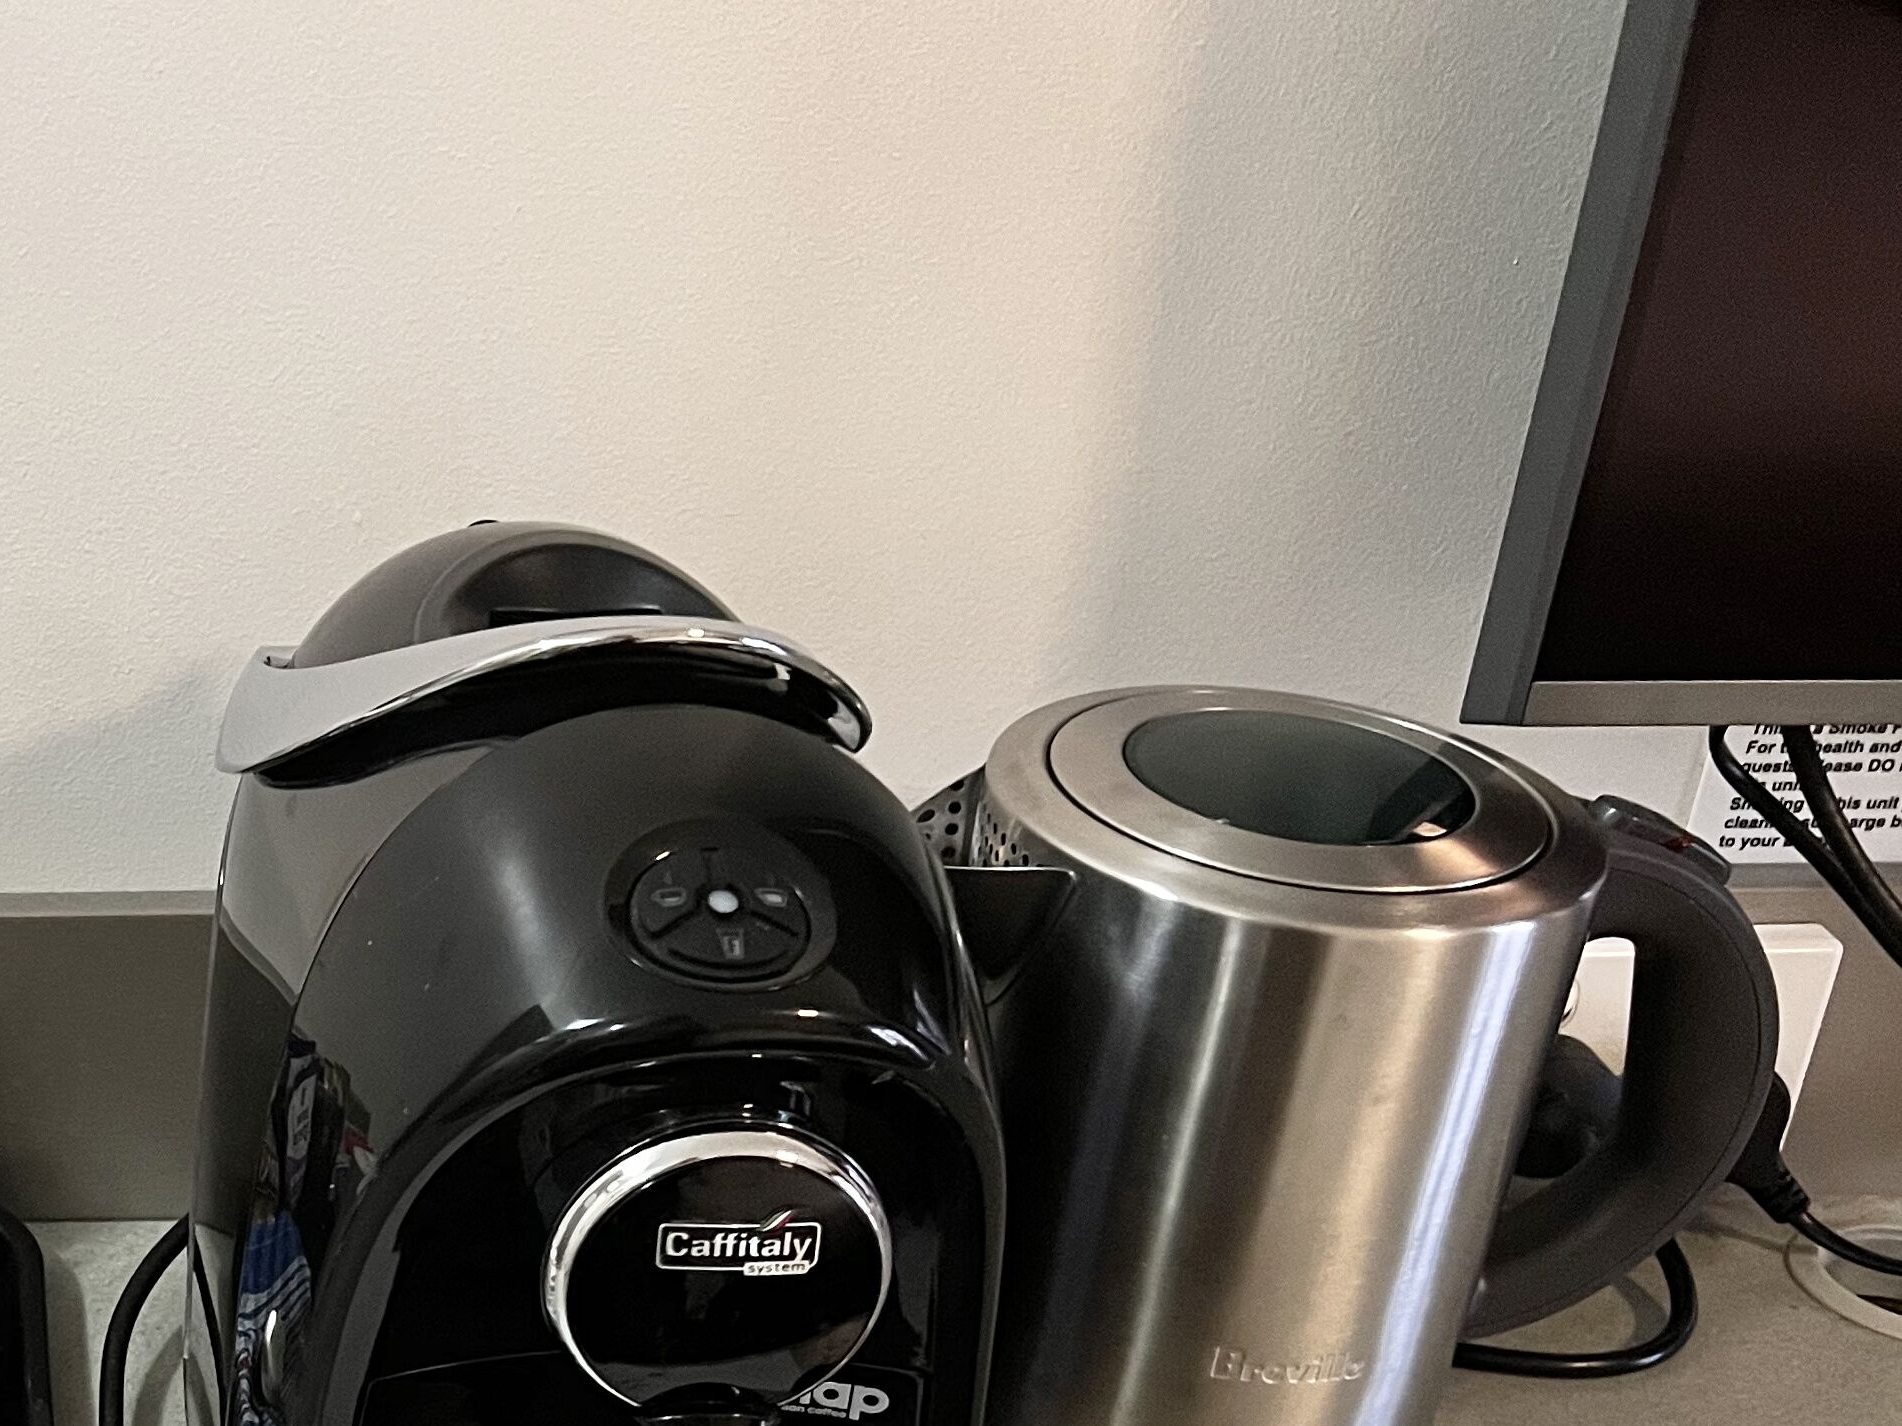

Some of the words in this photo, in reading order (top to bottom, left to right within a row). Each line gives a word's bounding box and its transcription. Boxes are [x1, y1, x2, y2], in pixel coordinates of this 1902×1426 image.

[1745, 740, 1777, 754] For
[1868, 758, 1896, 772] DO
[1866, 796, 1900, 810] unit
[1718, 835, 1736, 848] to
[1738, 836, 1781, 851] your
[665, 1231, 813, 1263] Caffitaly
[747, 1262, 807, 1275] system
[799, 1381, 891, 1420] ap
